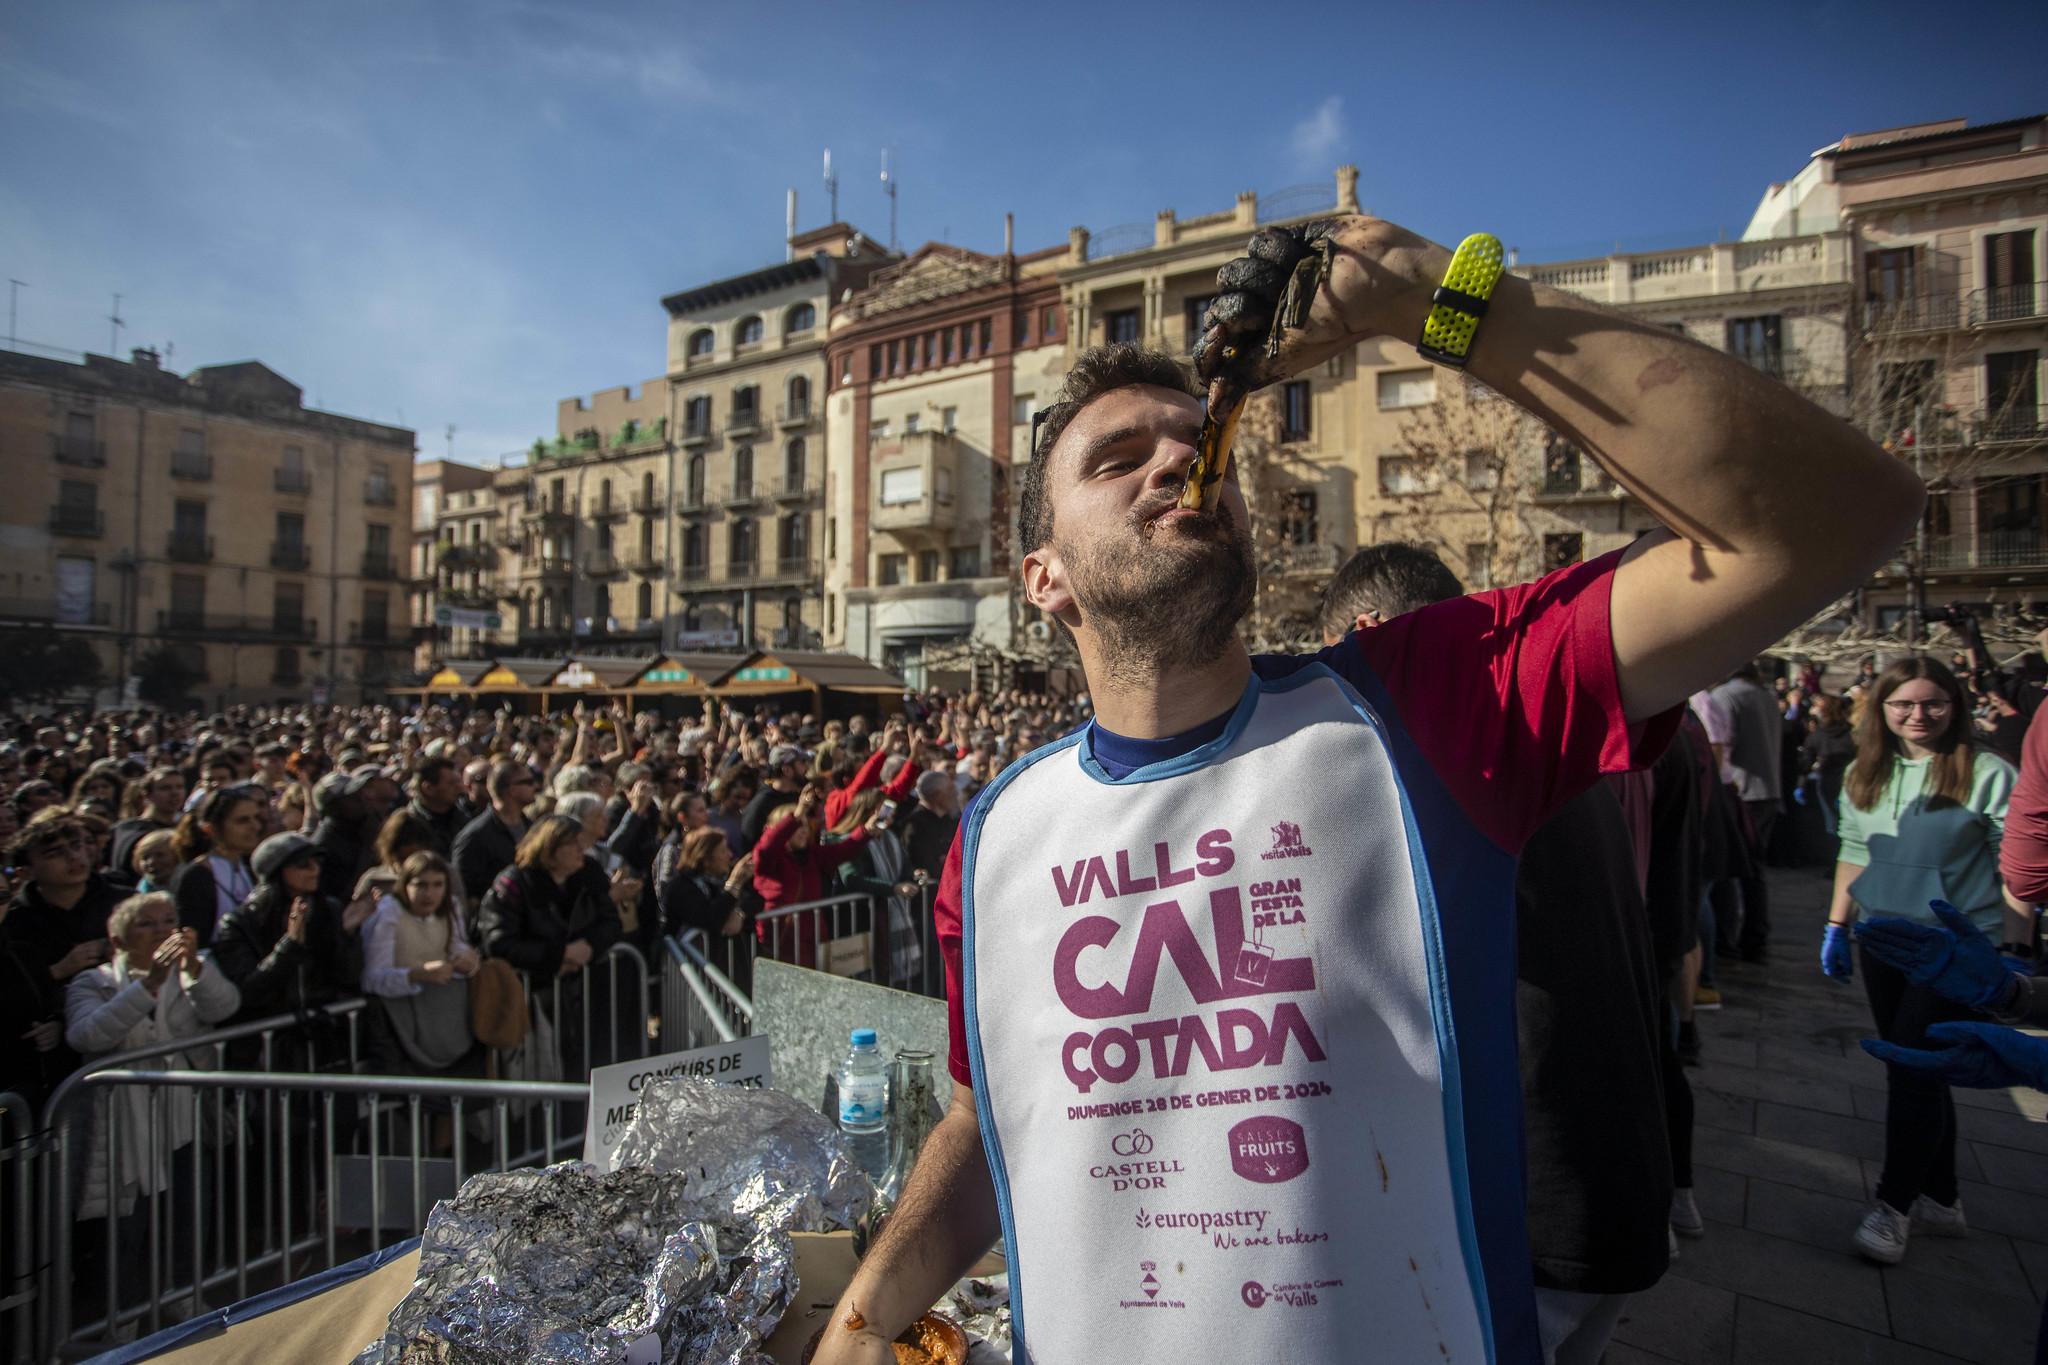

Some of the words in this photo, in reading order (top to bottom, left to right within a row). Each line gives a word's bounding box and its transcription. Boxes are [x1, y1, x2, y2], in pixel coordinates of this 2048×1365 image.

[1051, 829, 1235, 907] VALLS
[1249, 878, 1302, 897] GRAN
[1251, 895, 1304, 913] FESTA
[1253, 912, 1277, 928] DE
[1279, 909, 1306, 925] LA
[1053, 886, 1316, 1020] CAL
[1061, 1002, 1327, 1093] ÇOTADA
[718, 1052, 742, 1073] DE
[1067, 1099, 1143, 1121] DIUMENGE
[1146, 1097, 1167, 1113] 28
[1170, 1094, 1193, 1110] DE
[1196, 1089, 1251, 1107] GENER
[1254, 1085, 1281, 1101] DE
[1283, 1081, 1332, 1100] 2024
[1239, 1141, 1296, 1157] FRUITS
[1089, 1159, 1185, 1179] CASTELL
[1113, 1176, 1167, 1192] D'OR
[1155, 1209, 1268, 1234] europastry
[1213, 1231, 1241, 1250] We
[1245, 1234, 1273, 1247] are
[1277, 1227, 1329, 1245] bakers
[1283, 1291, 1318, 1307] Valls
